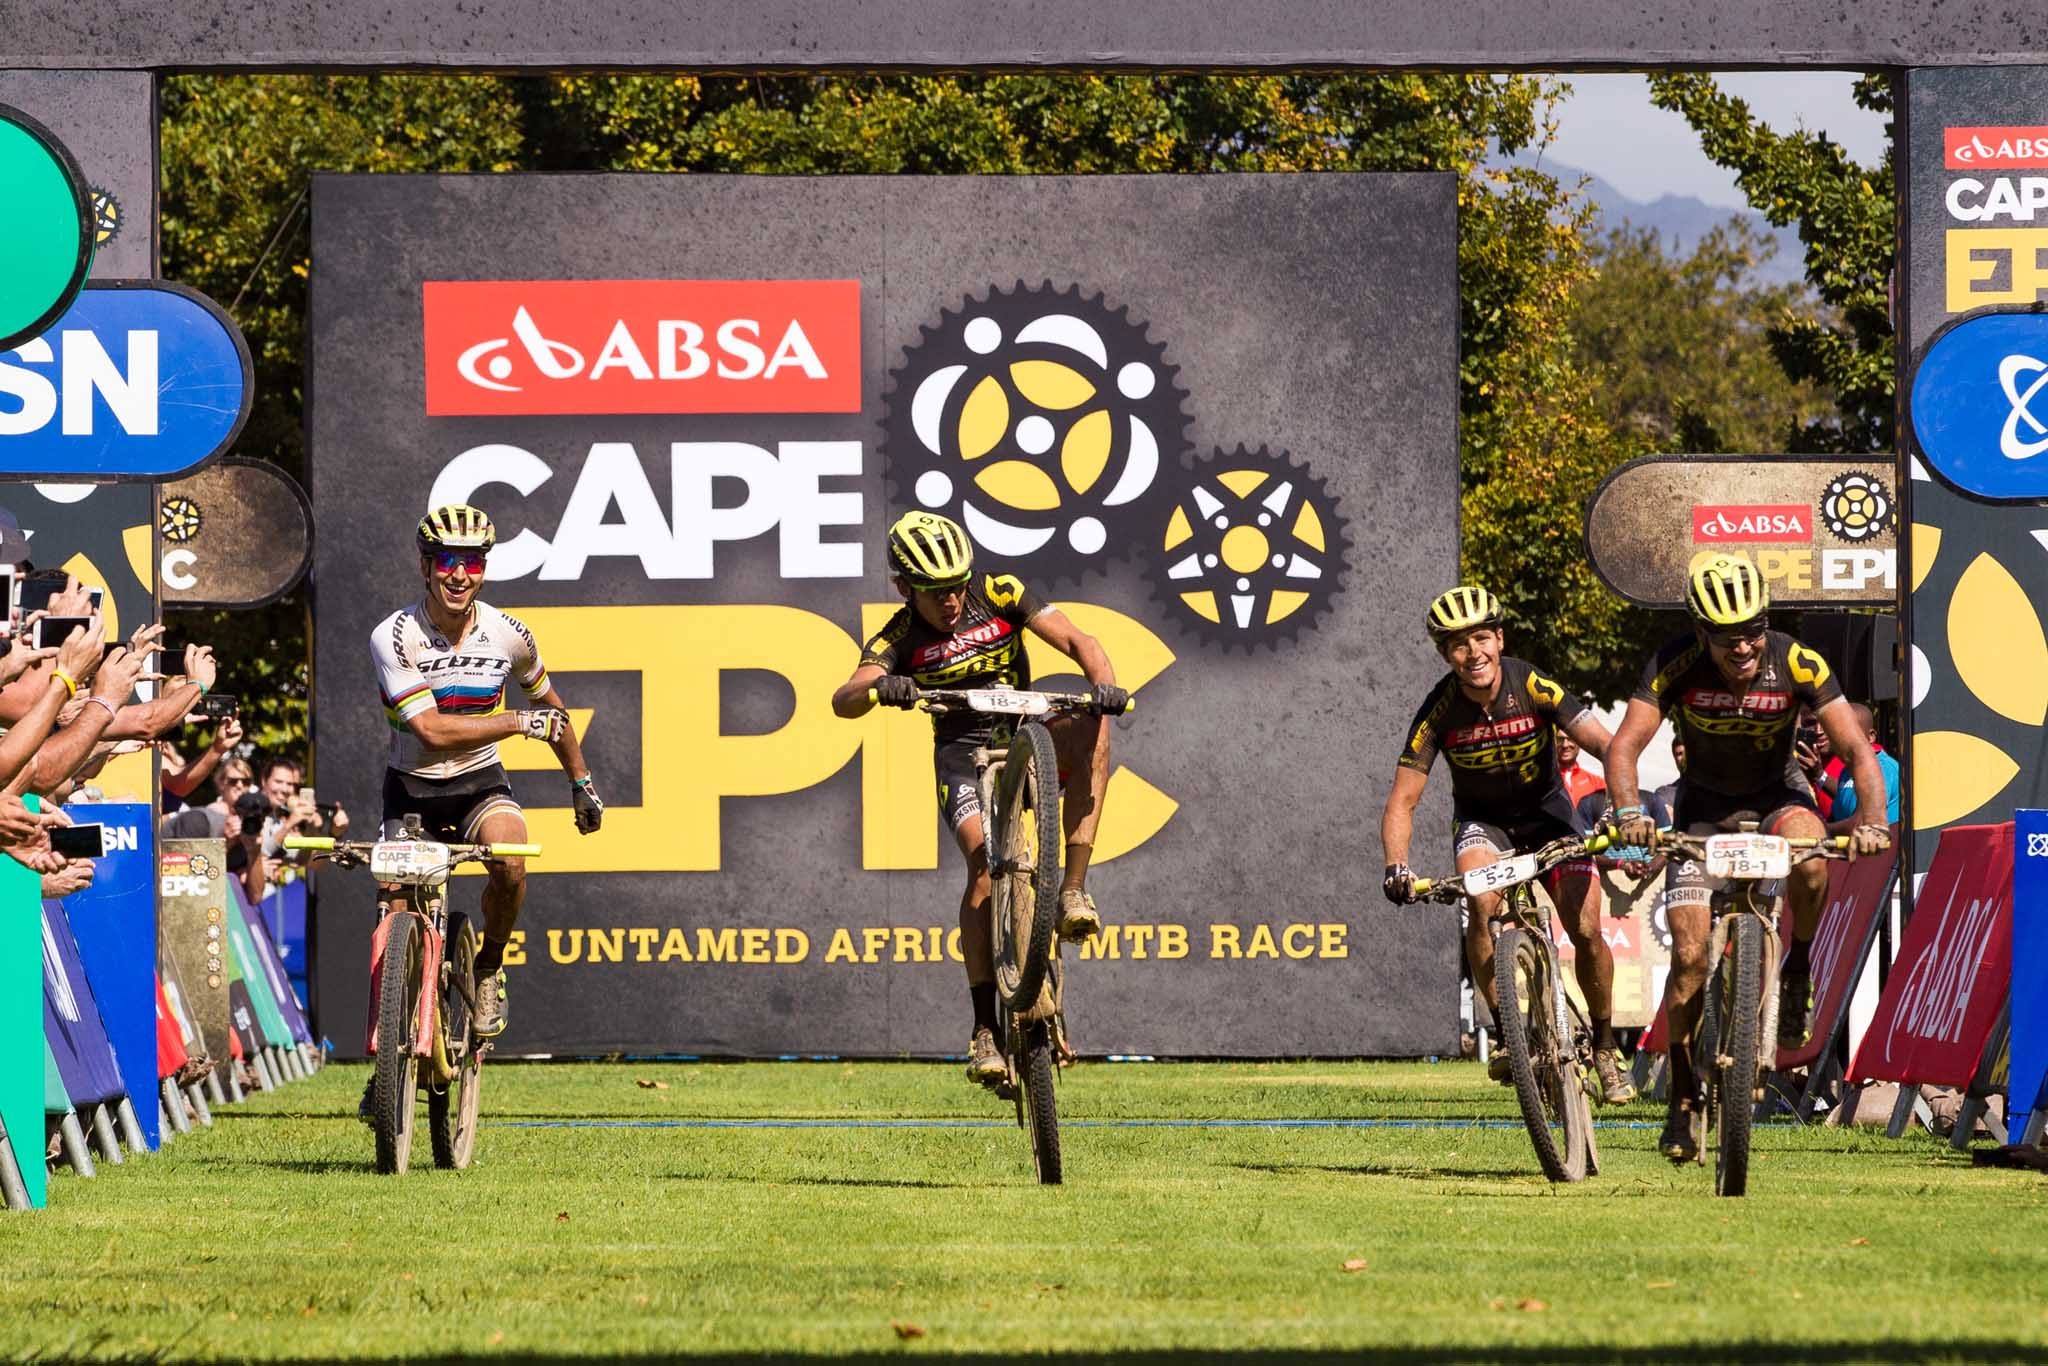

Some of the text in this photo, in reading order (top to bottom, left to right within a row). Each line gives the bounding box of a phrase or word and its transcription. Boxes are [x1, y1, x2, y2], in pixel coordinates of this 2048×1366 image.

[589, 319, 829, 380] ABSA
[428, 441, 864, 580] CAPE
[1737, 515, 1804, 535] ABSA
[162, 549, 198, 590] C
[417, 656, 509, 673] SCOTT
[1692, 691, 1788, 709] SRAM
[377, 851, 412, 863] CAPE
[1712, 849, 1749, 859] CAPE
[1486, 866, 1516, 886] 5-2
[1728, 860, 1768, 873] 18-1
[162, 876, 210, 897] EPIC
[547, 927, 810, 964] UNTAMED
[1079, 924, 1190, 961] MTB
[1210, 923, 1348, 960] RACE
